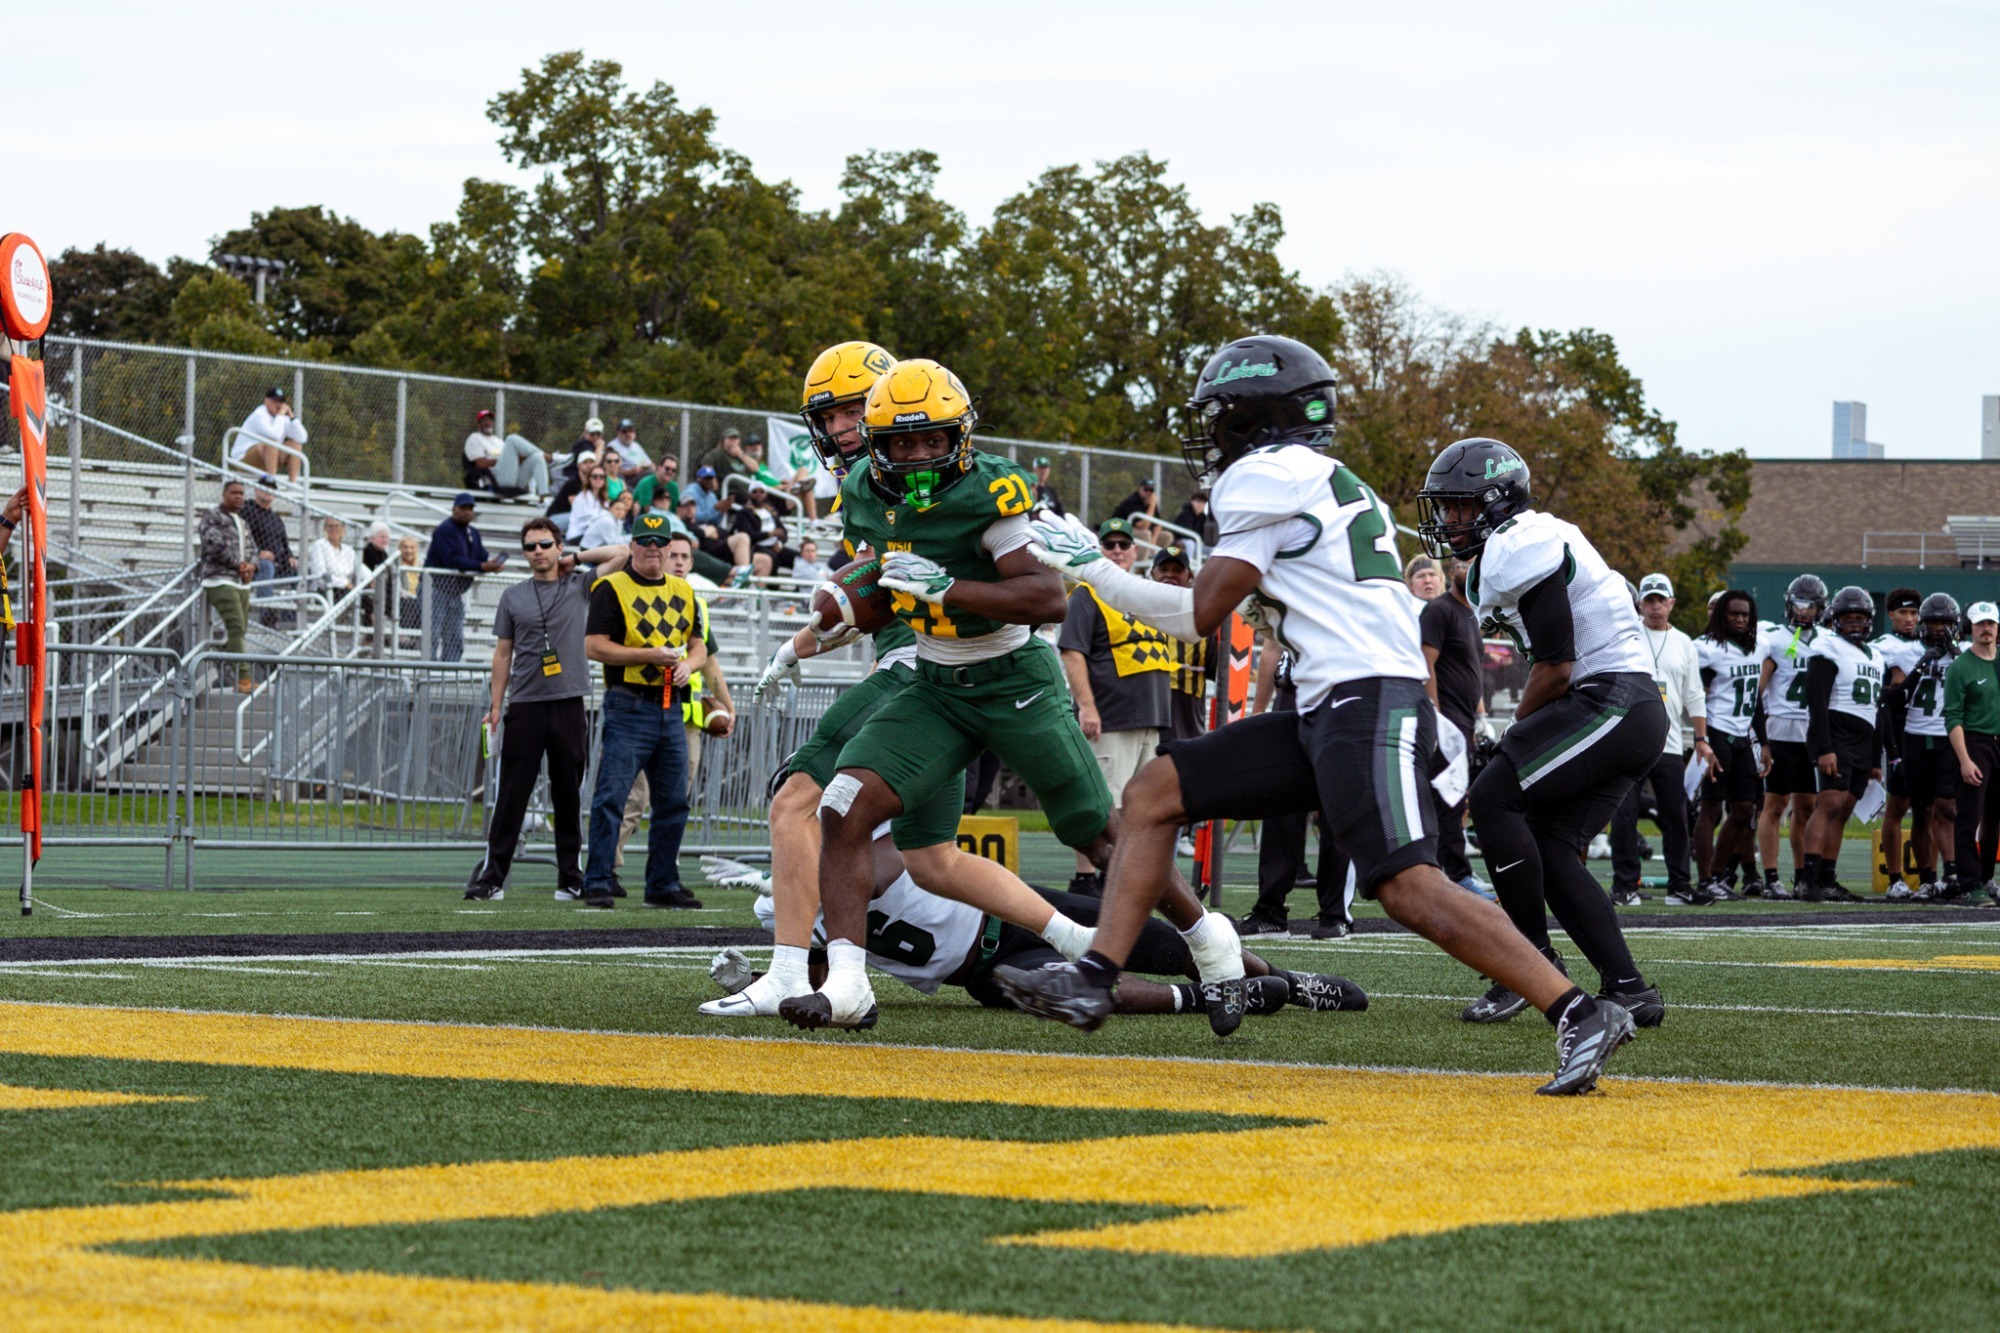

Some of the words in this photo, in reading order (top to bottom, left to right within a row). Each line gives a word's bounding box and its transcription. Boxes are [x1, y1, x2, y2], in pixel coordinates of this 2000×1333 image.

[1212, 359, 1279, 385] Lakers
[895, 413, 926, 423] Riddell
[1484, 456, 1522, 479] Lakers
[989, 473, 1033, 517] 21
[1329, 464, 1405, 582] 2
[887, 541, 912, 553] WSU
[1732, 677, 1758, 717] 13
[1912, 677, 1942, 717] 4
